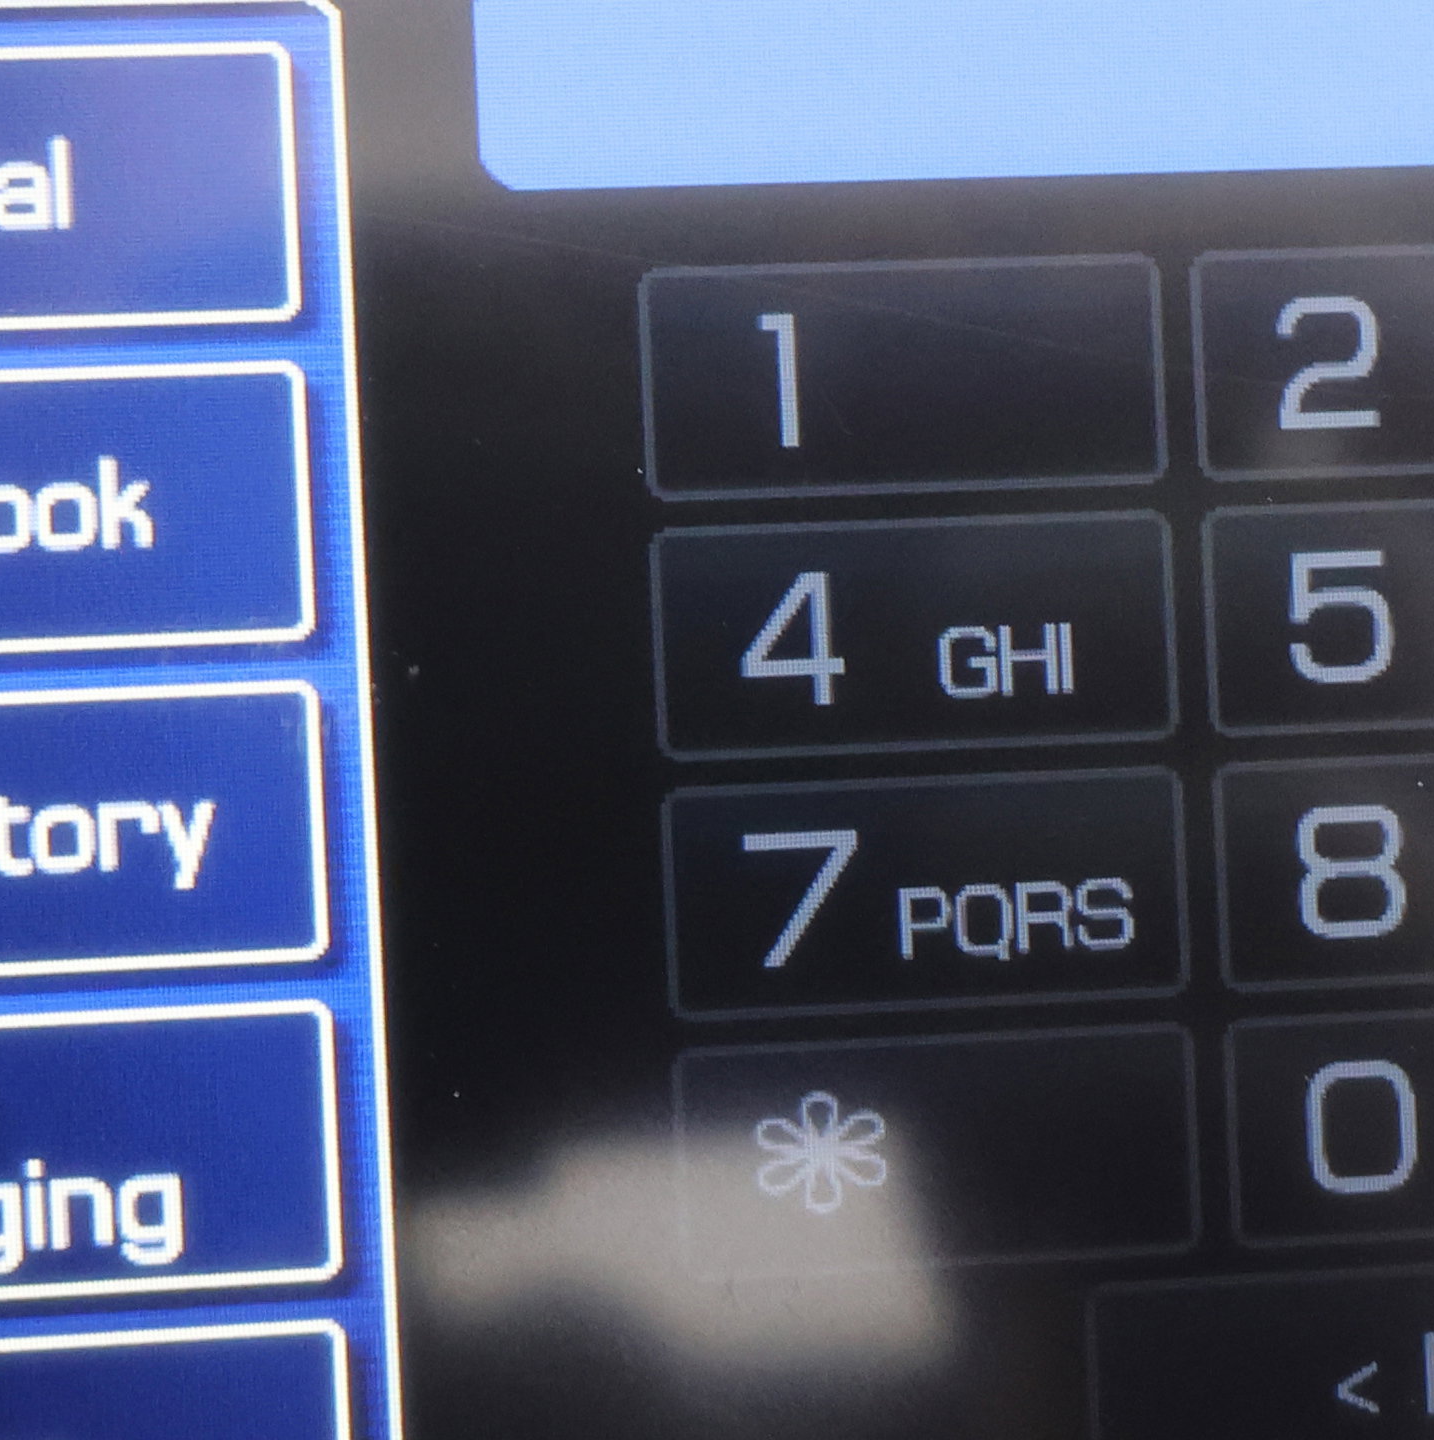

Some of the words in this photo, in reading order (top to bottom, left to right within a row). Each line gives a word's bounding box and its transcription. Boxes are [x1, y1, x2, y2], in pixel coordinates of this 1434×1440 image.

[762, 311, 801, 448] 1
[1277, 296, 1381, 431] 2
[740, 570, 846, 705] 4
[939, 622, 1075, 698] GHI
[1289, 549, 1395, 684] 5
[742, 828, 860, 969] 7
[900, 879, 1135, 962] PQRS
[1299, 804, 1404, 939] 8
